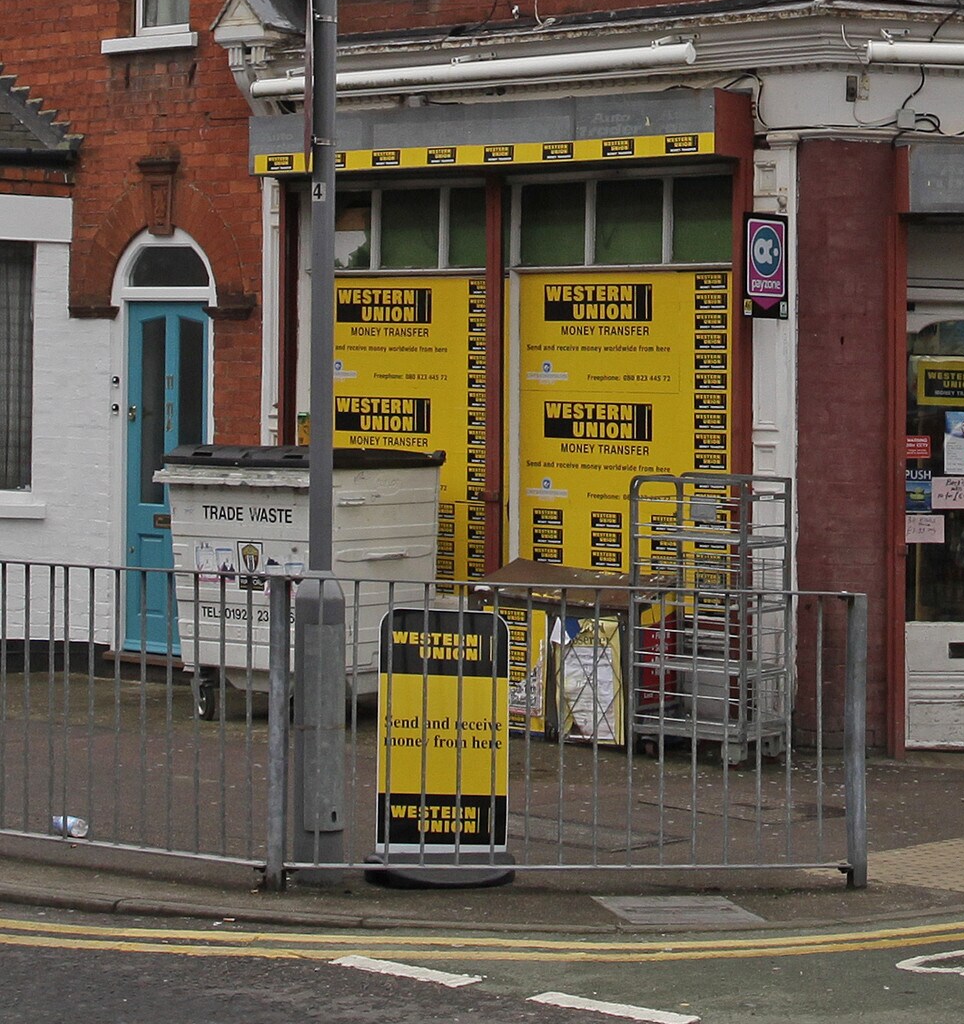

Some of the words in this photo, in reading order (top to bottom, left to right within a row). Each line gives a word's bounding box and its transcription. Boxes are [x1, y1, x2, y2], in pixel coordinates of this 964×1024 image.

[313, 184, 323, 200] 4
[751, 279, 781, 292] payzone
[338, 289, 415, 305] WESTERN
[546, 285, 632, 302] WESTERN
[361, 306, 415, 322] UNION
[572, 304, 632, 320] UNION
[351, 327, 381, 337] MONEY
[384, 327, 429, 337] TRANSFER
[561, 326, 595, 336] MONEY
[598, 326, 650, 336] TRANSFER
[336, 398, 413, 414] WESTERN
[546, 403, 632, 420] WESTERN
[360, 415, 413, 431] UNION
[572, 422, 632, 439] UNION
[350, 436, 380, 446] MONEY
[383, 437, 428, 447] TRANSFER
[561, 443, 595, 453] MONEY
[598, 445, 649, 456] TRANSFER
[581, 463, 601, 471] money
[603, 464, 637, 472] worldwide
[905, 469, 932, 480] PUSH
[202, 505, 243, 521] TRADE
[249, 508, 292, 523] WASTE
[202, 606, 221, 618] TEL:
[225, 608, 250, 620] 0192
[392, 631, 478, 647] WESTERN
[419, 646, 478, 661] UNION
[385, 716, 419, 728] Send
[425, 717, 450, 730] and
[455, 718, 502, 731] receive
[434, 735, 467, 748] from
[472, 736, 502, 749] here
[390, 805, 476, 819] WESTERN
[417, 820, 476, 833] UNION
